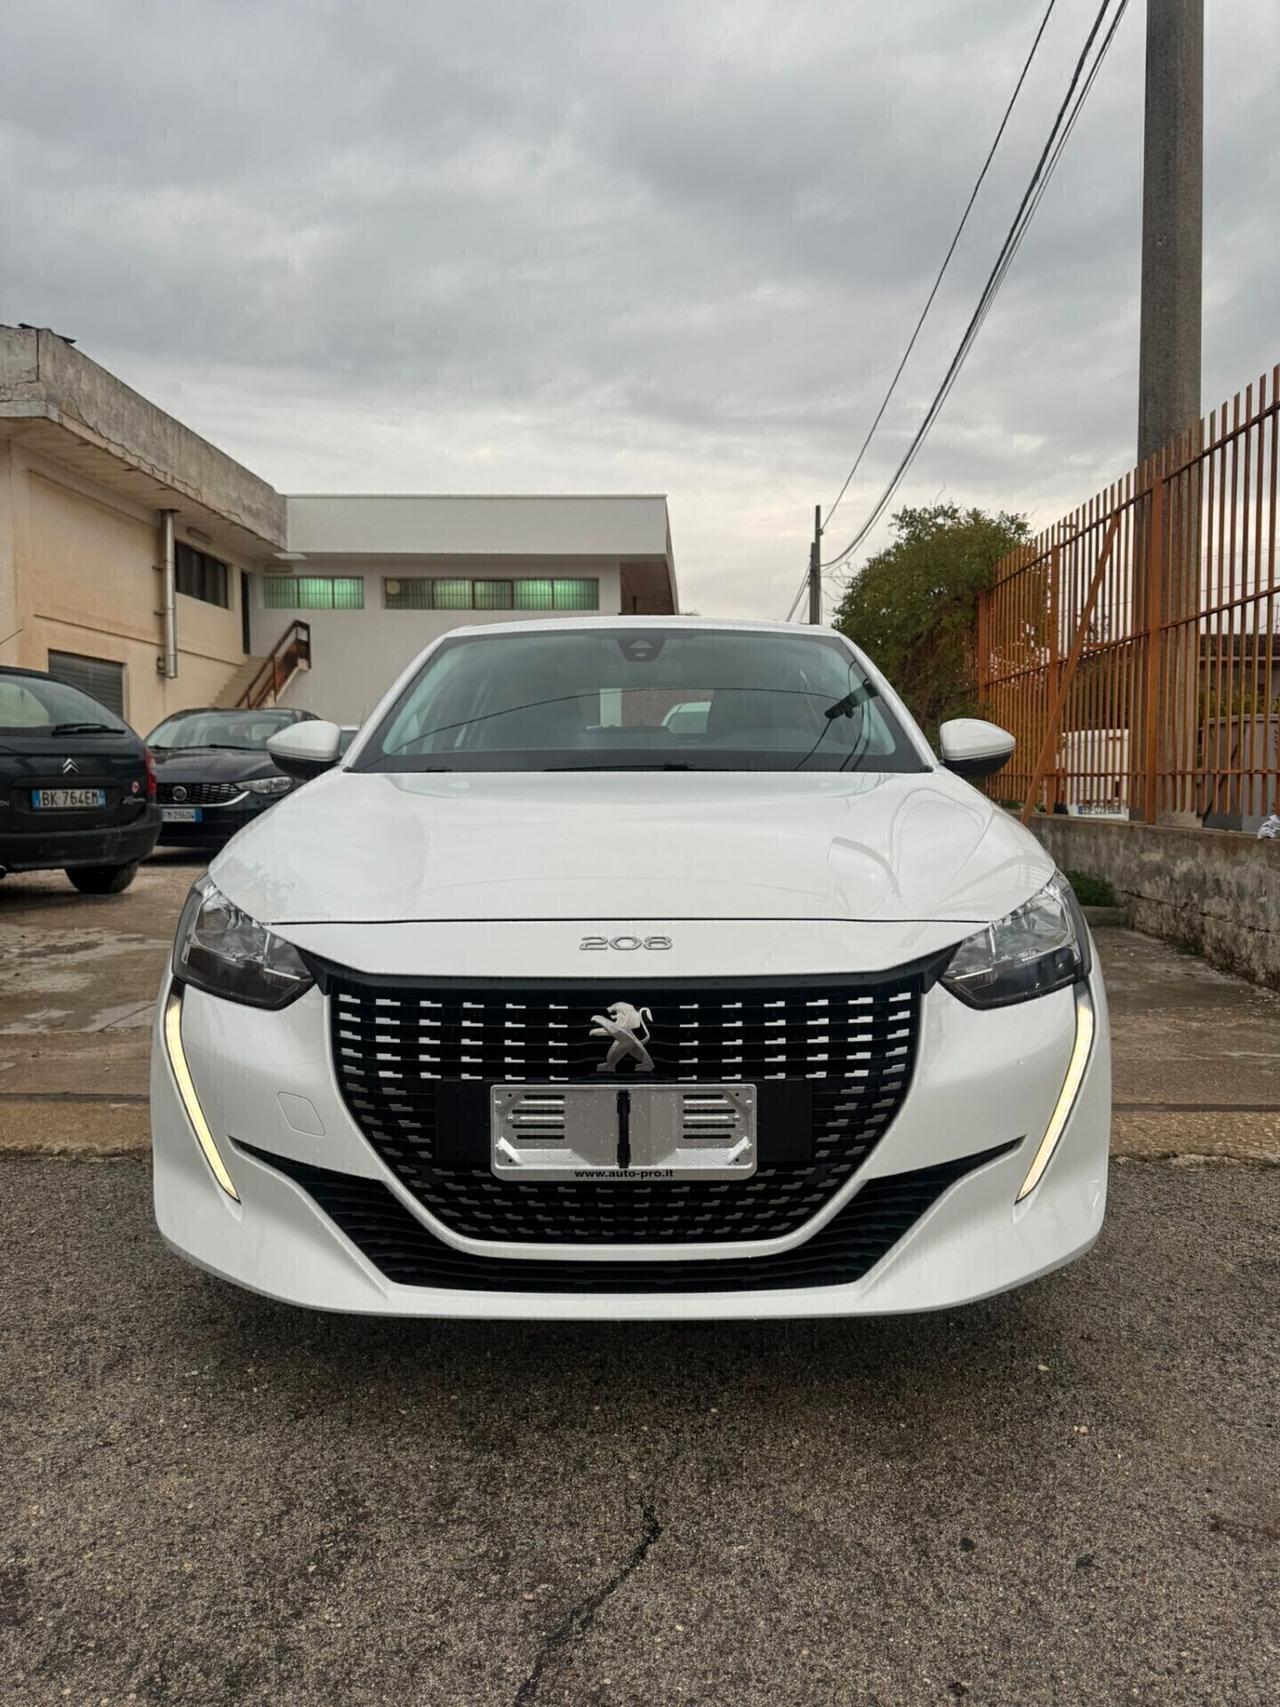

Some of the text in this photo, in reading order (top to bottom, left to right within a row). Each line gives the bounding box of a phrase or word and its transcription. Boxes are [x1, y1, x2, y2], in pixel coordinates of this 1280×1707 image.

[42, 791, 98, 806] BK 764EM
[579, 936, 673, 950] 208
[574, 1169, 674, 1179] www.auto-pro.it
